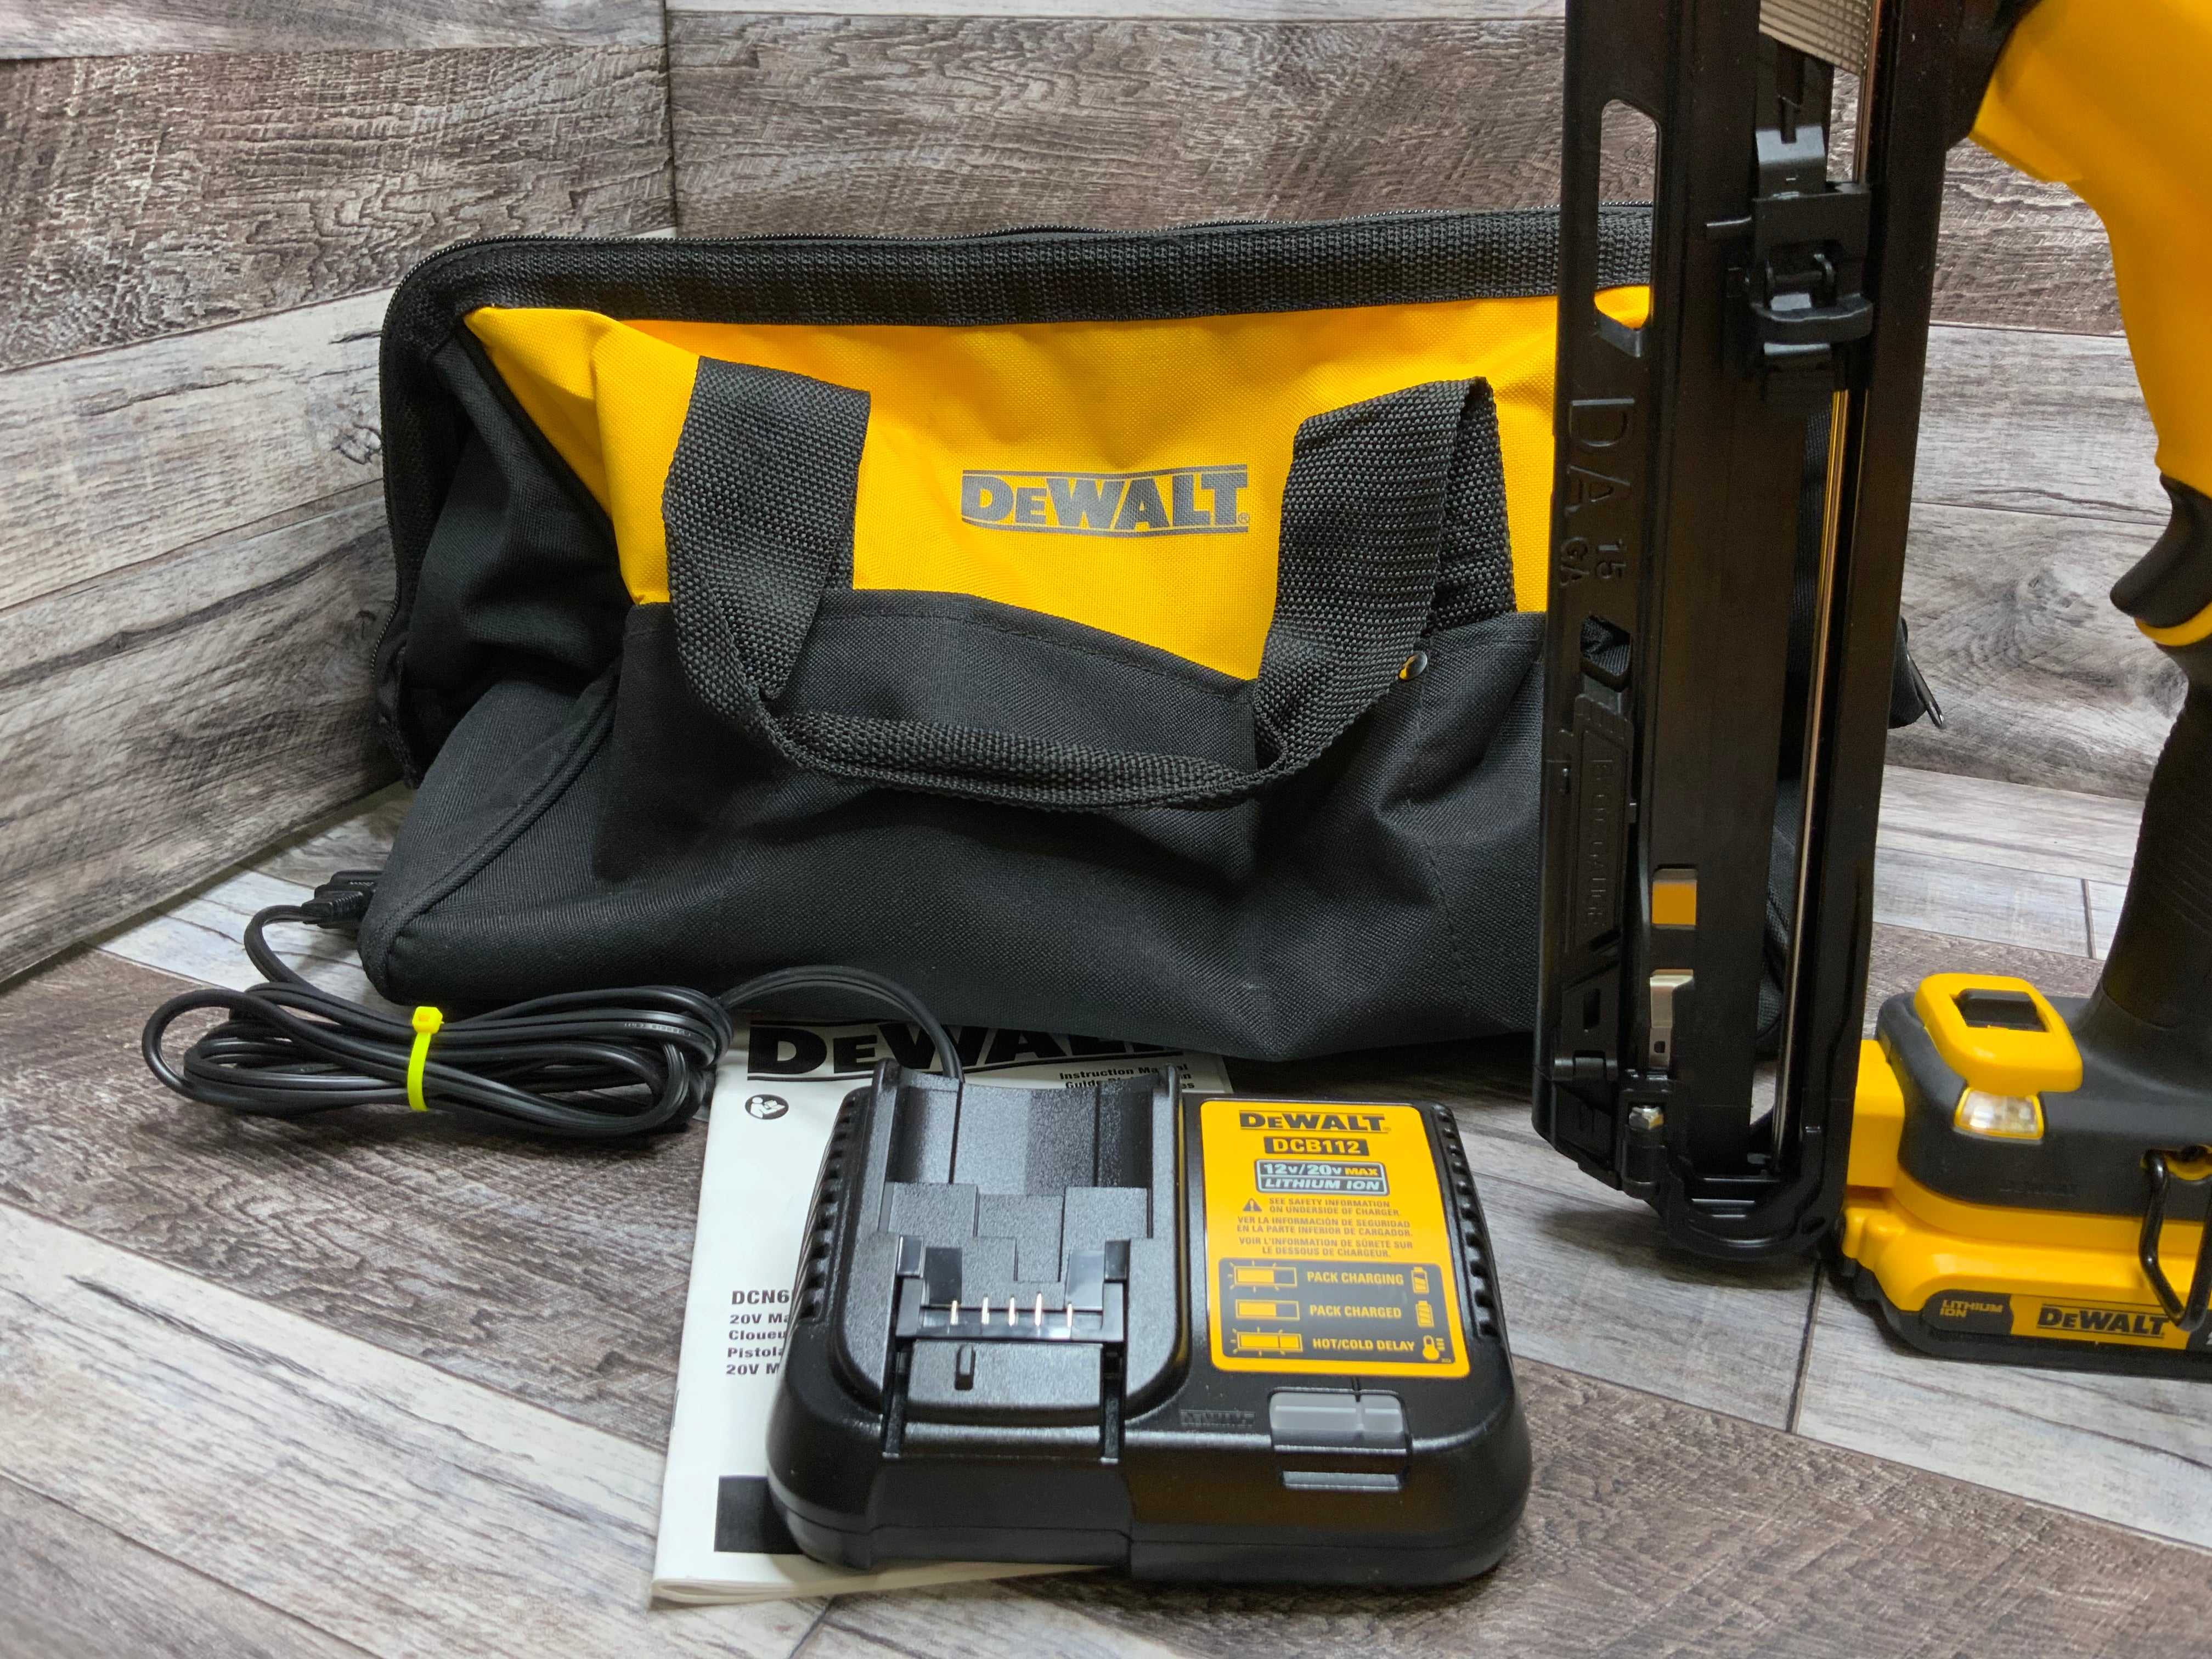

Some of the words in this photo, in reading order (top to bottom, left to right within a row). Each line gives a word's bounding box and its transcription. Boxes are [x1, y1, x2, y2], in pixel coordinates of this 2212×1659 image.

[1060, 1068, 1133, 1080] Instruction
[1138, 1064, 1188, 1074] Maal
[1239, 1112, 1385, 1131] DEWALT
[1272, 1138, 1361, 1154] DCB112
[1345, 1167, 1379, 1176] MAX
[1265, 1178, 1340, 1189] LITHIUM
[1346, 1180, 1380, 1190] ION
[1325, 1199, 1390, 1207] INFORMATION
[1356, 1219, 1410, 1228] SEGURIDAD
[1267, 1225, 1295, 1233] PARTE
[1299, 1226, 1341, 1234] INFERIOR
[1358, 1228, 1413, 1236] CARGADOR.
[1264, 1237, 1338, 1246] L'INFORMATION
[1276, 1246, 1319, 1255] DESSOUS
[1338, 1248, 1391, 1257] CHARGEUR.
[1307, 1271, 1338, 1283] PACK
[1341, 1272, 1404, 1285] CHARGING
[732, 1290, 793, 1305] DCN6
[1310, 1305, 1341, 1316] PACK
[1344, 1306, 1402, 1319] CHARGED
[1940, 1307, 1967, 1317] ION
[1942, 1300, 2003, 1313] LITHIUM
[730, 1313, 762, 1324] 20V
[1312, 1338, 1373, 1350] HOT/COLD
[1376, 1340, 1415, 1352] DELAY
[726, 1363, 759, 1375] 20V
